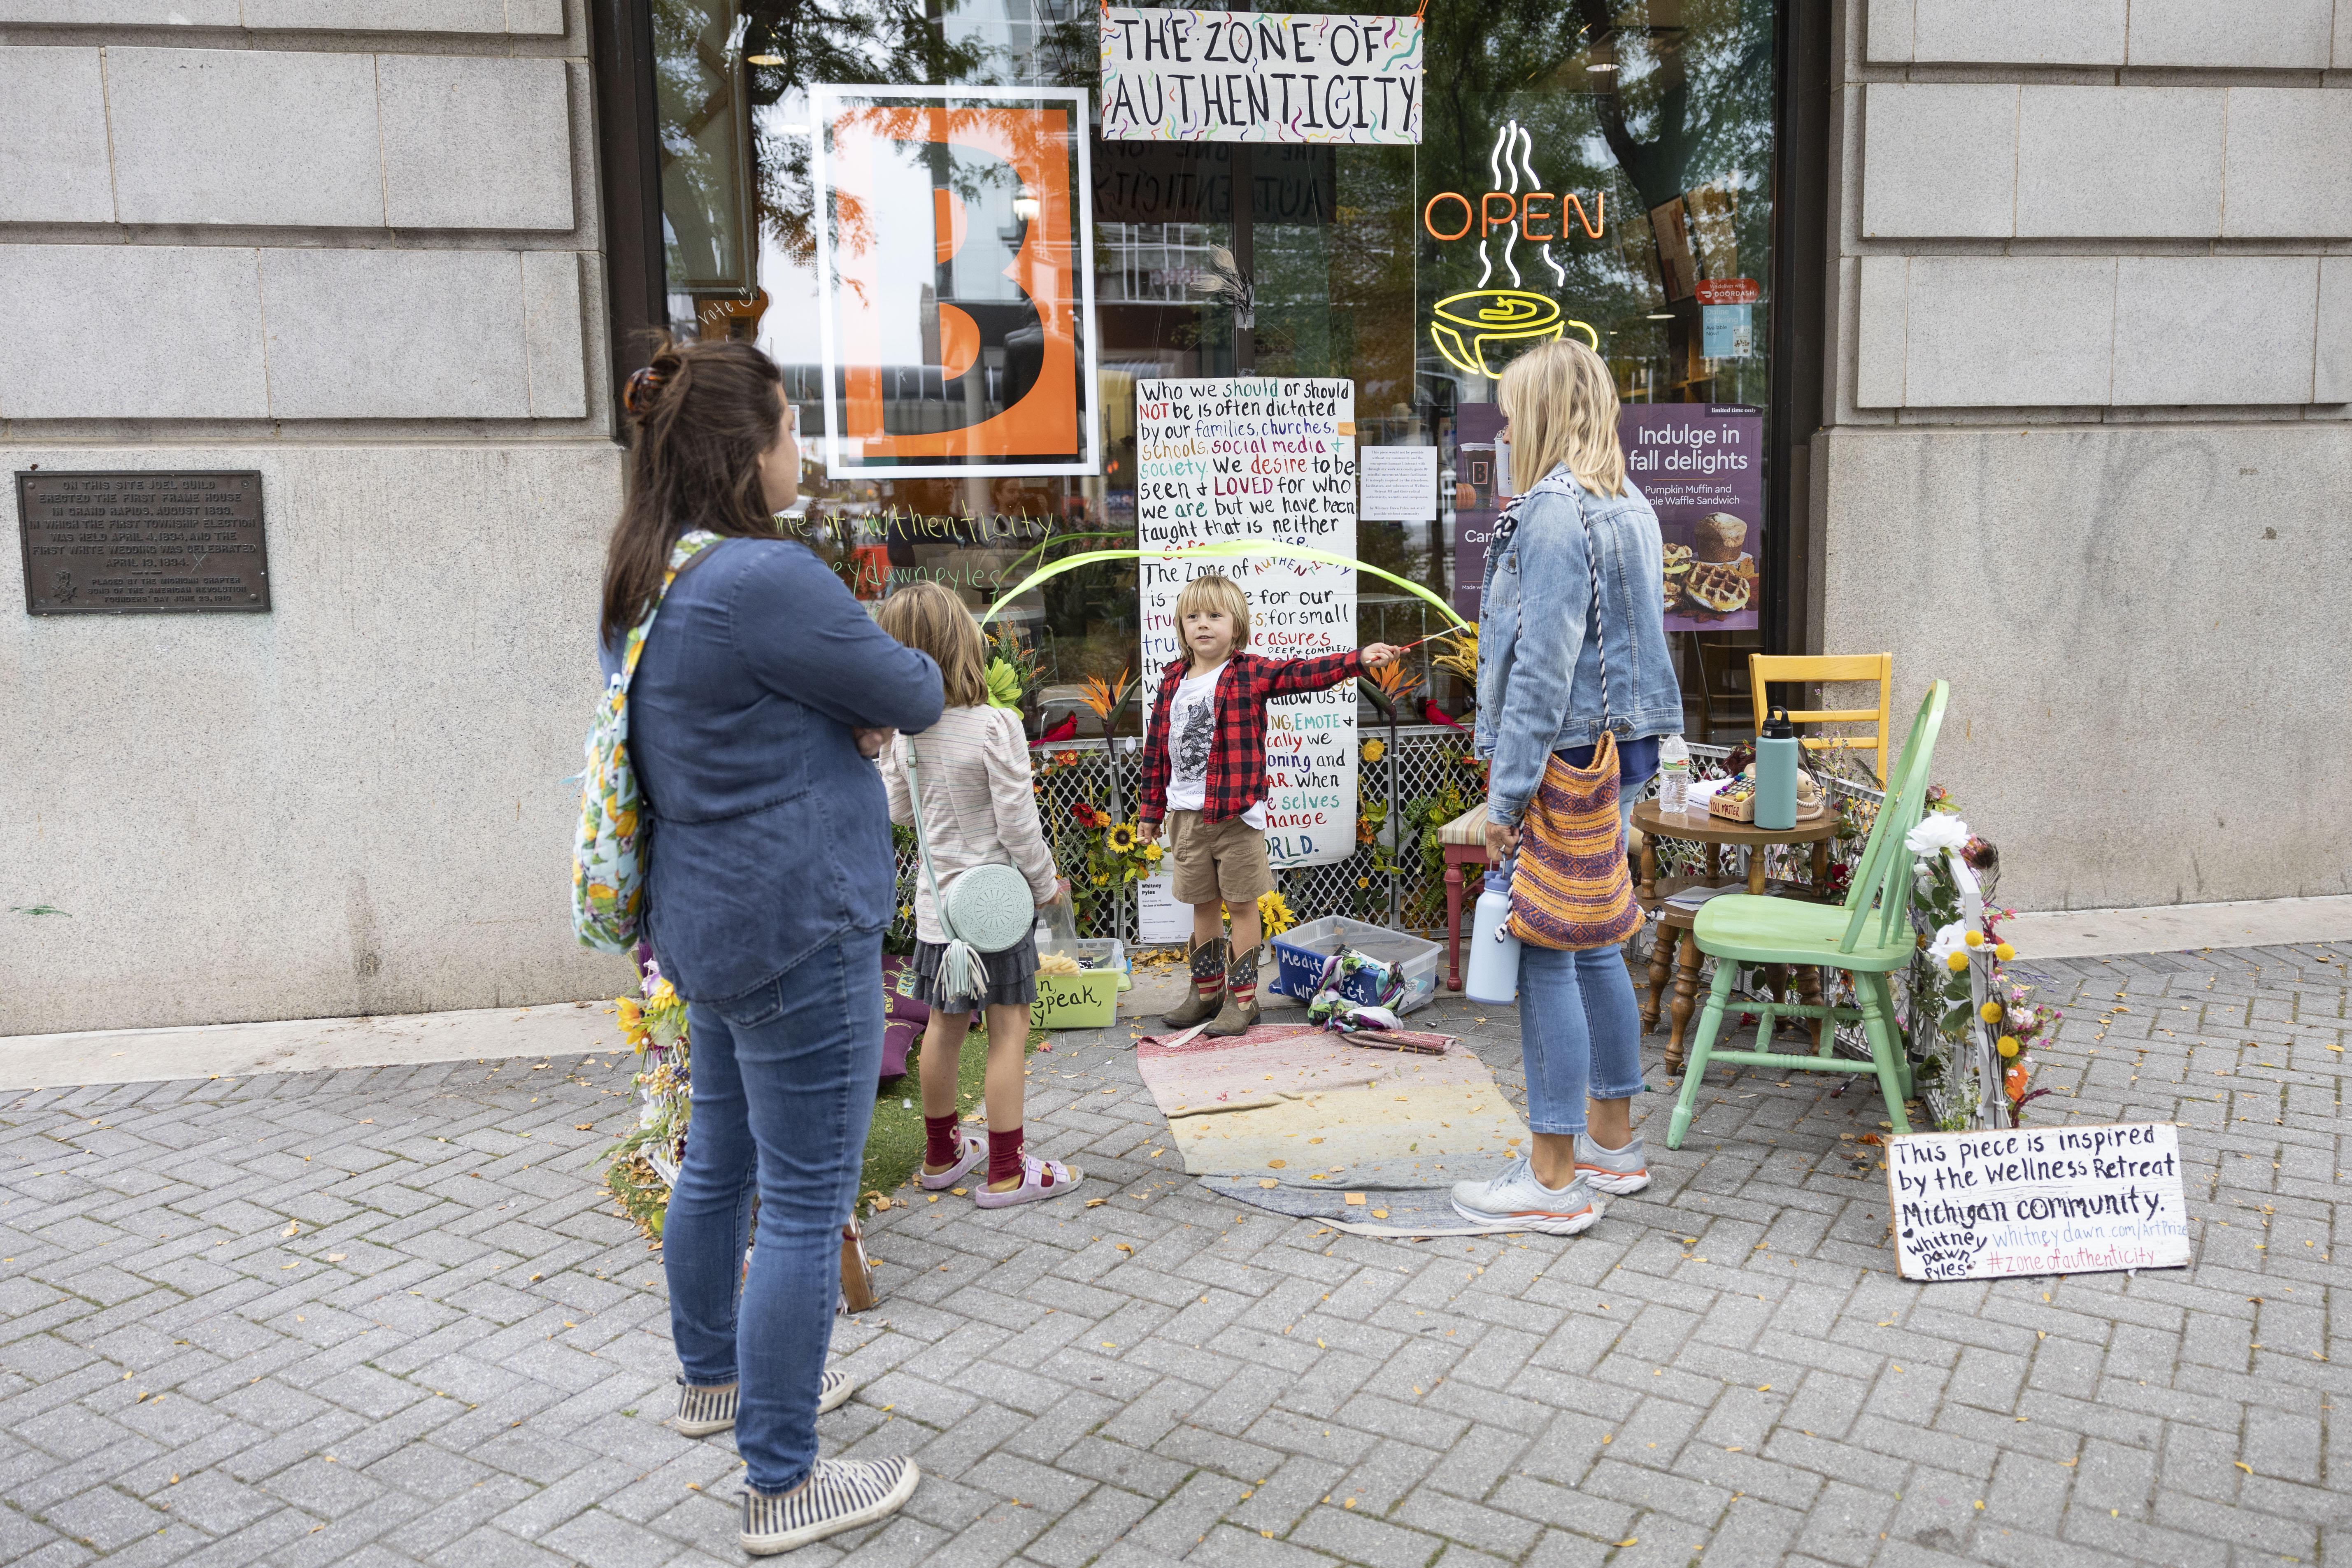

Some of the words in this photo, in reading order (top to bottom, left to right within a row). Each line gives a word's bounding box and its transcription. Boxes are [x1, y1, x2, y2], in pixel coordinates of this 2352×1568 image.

[1114, 19, 1191, 62] THE
[1205, 21, 1315, 63] ZONE
[1331, 24, 1382, 66] OF
[1111, 74, 1416, 131] AUTHENTICITY
[1425, 191, 1604, 241] OPEN
[1141, 382, 1182, 401] Who
[1190, 384, 1217, 397] we
[1223, 378, 1278, 397] should
[1284, 383, 1300, 396] or
[1304, 379, 1349, 399] should
[1140, 403, 1169, 420] NOT
[1173, 402, 1193, 420] be
[1199, 404, 1212, 417] is
[1216, 400, 1261, 416] often
[1266, 398, 1336, 416] dictated
[1142, 423, 1159, 447] by
[1166, 424, 1190, 438] our
[1195, 419, 1258, 437] families,
[1262, 418, 1335, 436] churches,
[1639, 423, 1716, 448] Indulge
[1722, 424, 1739, 444] in
[1142, 437, 1209, 461] schools,
[1212, 437, 1266, 454] social
[1273, 435, 1326, 454] media
[1140, 459, 1208, 481] society.
[1213, 458, 1242, 473] We
[1252, 454, 1307, 475] desire
[1311, 456, 1330, 473] to
[1335, 454, 1355, 475] be
[1629, 450, 1658, 470] fall
[1665, 449, 1748, 474] delights
[1474, 463, 1486, 483] B
[63, 481, 78, 490] ON
[82, 481, 110, 490] THIS
[115, 481, 144, 490] SITE
[149, 481, 177, 489] JOEL
[182, 481, 215, 489] GUILD
[1141, 481, 1189, 500] seen
[1215, 476, 1273, 496] LOVED
[1277, 476, 1305, 494] for
[1312, 474, 1351, 494] who
[1645, 485, 1683, 496] Pumpkin
[1686, 484, 1712, 493] Muffin
[1715, 484, 1731, 493] and
[39, 494, 90, 503] ERECTED
[94, 494, 117, 503] THE
[123, 493, 156, 503] FIRST
[162, 493, 200, 502] FRAME
[205, 493, 242, 502] HOUSE
[1142, 505, 1169, 519] we
[1175, 502, 1208, 517] are
[1215, 496, 1243, 516] but
[1249, 499, 1275, 514] we
[1283, 496, 1319, 514] have
[1324, 496, 1354, 515] been
[1666, 496, 1694, 505] Waffle
[1697, 495, 1740, 505] Sandwich
[52, 507, 63, 516] IN
[69, 507, 105, 516] GRAND
[156, 506, 200, 515] AUGUST
[30, 520, 40, 529] IN
[44, 520, 79, 529] WHICH
[82, 519, 104, 528] THE
[109, 519, 140, 528] FIRST
[144, 519, 199, 528] TOWNSHIP
[203, 518, 255, 528] ELECTION
[1141, 521, 1197, 544] taught
[1204, 517, 1241, 536] that
[1247, 517, 1262, 533] is
[1273, 514, 1339, 535] neither
[822, 505, 846, 540] of
[858, 500, 1054, 572] authenticity
[33, 546, 65, 555] FIRST
[67, 545, 104, 554] WHITE
[107, 545, 157, 554] WEDDING
[160, 545, 183, 554] WAS
[186, 544, 256, 554] CELEBRATED
[106, 558, 138, 567] APRIL
[1141, 563, 1179, 588] The
[1233, 558, 1249, 579] of
[1151, 590, 1166, 607] is
[1259, 591, 1290, 605] for
[1300, 590, 1333, 605] our
[1267, 609, 1293, 625] for
[1299, 604, 1348, 625] small
[1305, 644, 1354, 654] COMPLETE
[1317, 692, 1335, 704] us
[1340, 687, 1356, 703] to
[1295, 712, 1340, 730] EMOTE
[1307, 733, 1333, 745] we
[1317, 748, 1345, 767] and
[1295, 772, 1340, 788] When
[1282, 791, 1340, 810] selves
[1710, 800, 1719, 813] YOU
[1722, 804, 1740, 817] MATTER
[1265, 810, 1327, 828] hange
[1032, 985, 1102, 1014] speak,
[1894, 1142, 1947, 1164] This
[1960, 1136, 2019, 1167] piece
[2027, 1134, 2044, 1153] is
[2059, 1125, 2155, 1156] inspired
[1898, 1170, 1926, 1197] by
[1934, 1167, 1977, 1190] the
[1984, 1157, 2088, 1184] Wellness
[2094, 1153, 2175, 1179] Retreat
[1902, 1198, 2009, 1228] Michigan
[2017, 1185, 2165, 1221] community.
